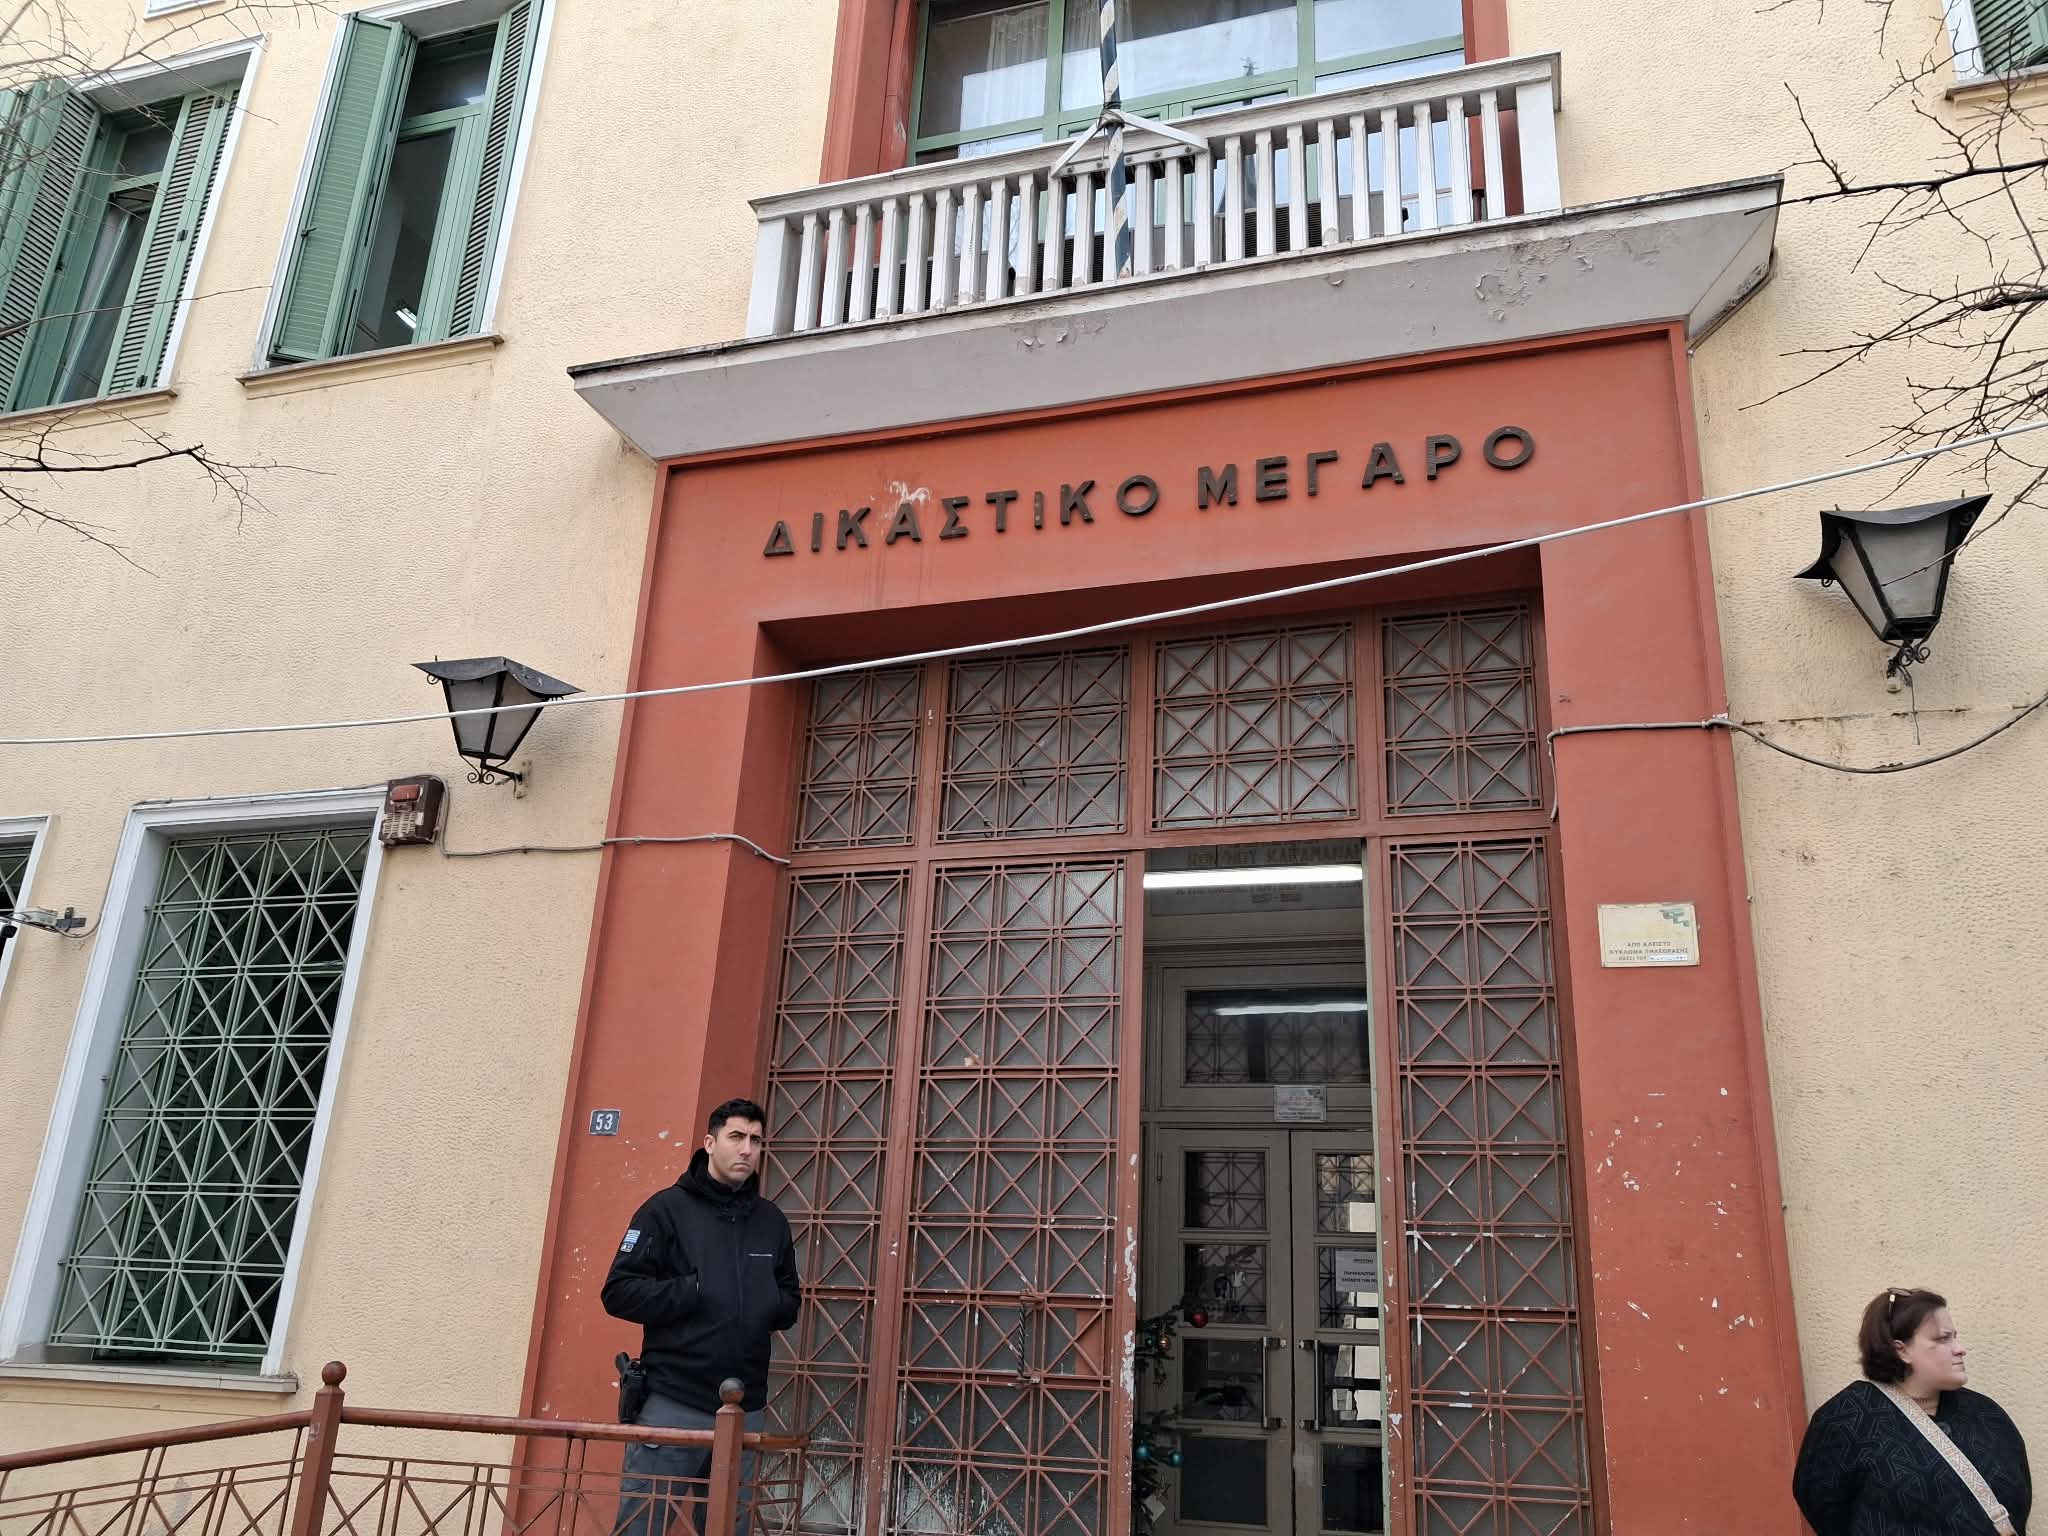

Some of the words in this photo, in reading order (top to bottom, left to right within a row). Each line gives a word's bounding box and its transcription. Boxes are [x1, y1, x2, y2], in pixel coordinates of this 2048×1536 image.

[763, 474, 1160, 556] ΔΙΚΑΣΤΙΚΟ
[1197, 425, 1535, 510] ΜΕΓΑΡΟ
[595, 1113, 613, 1131] 53
